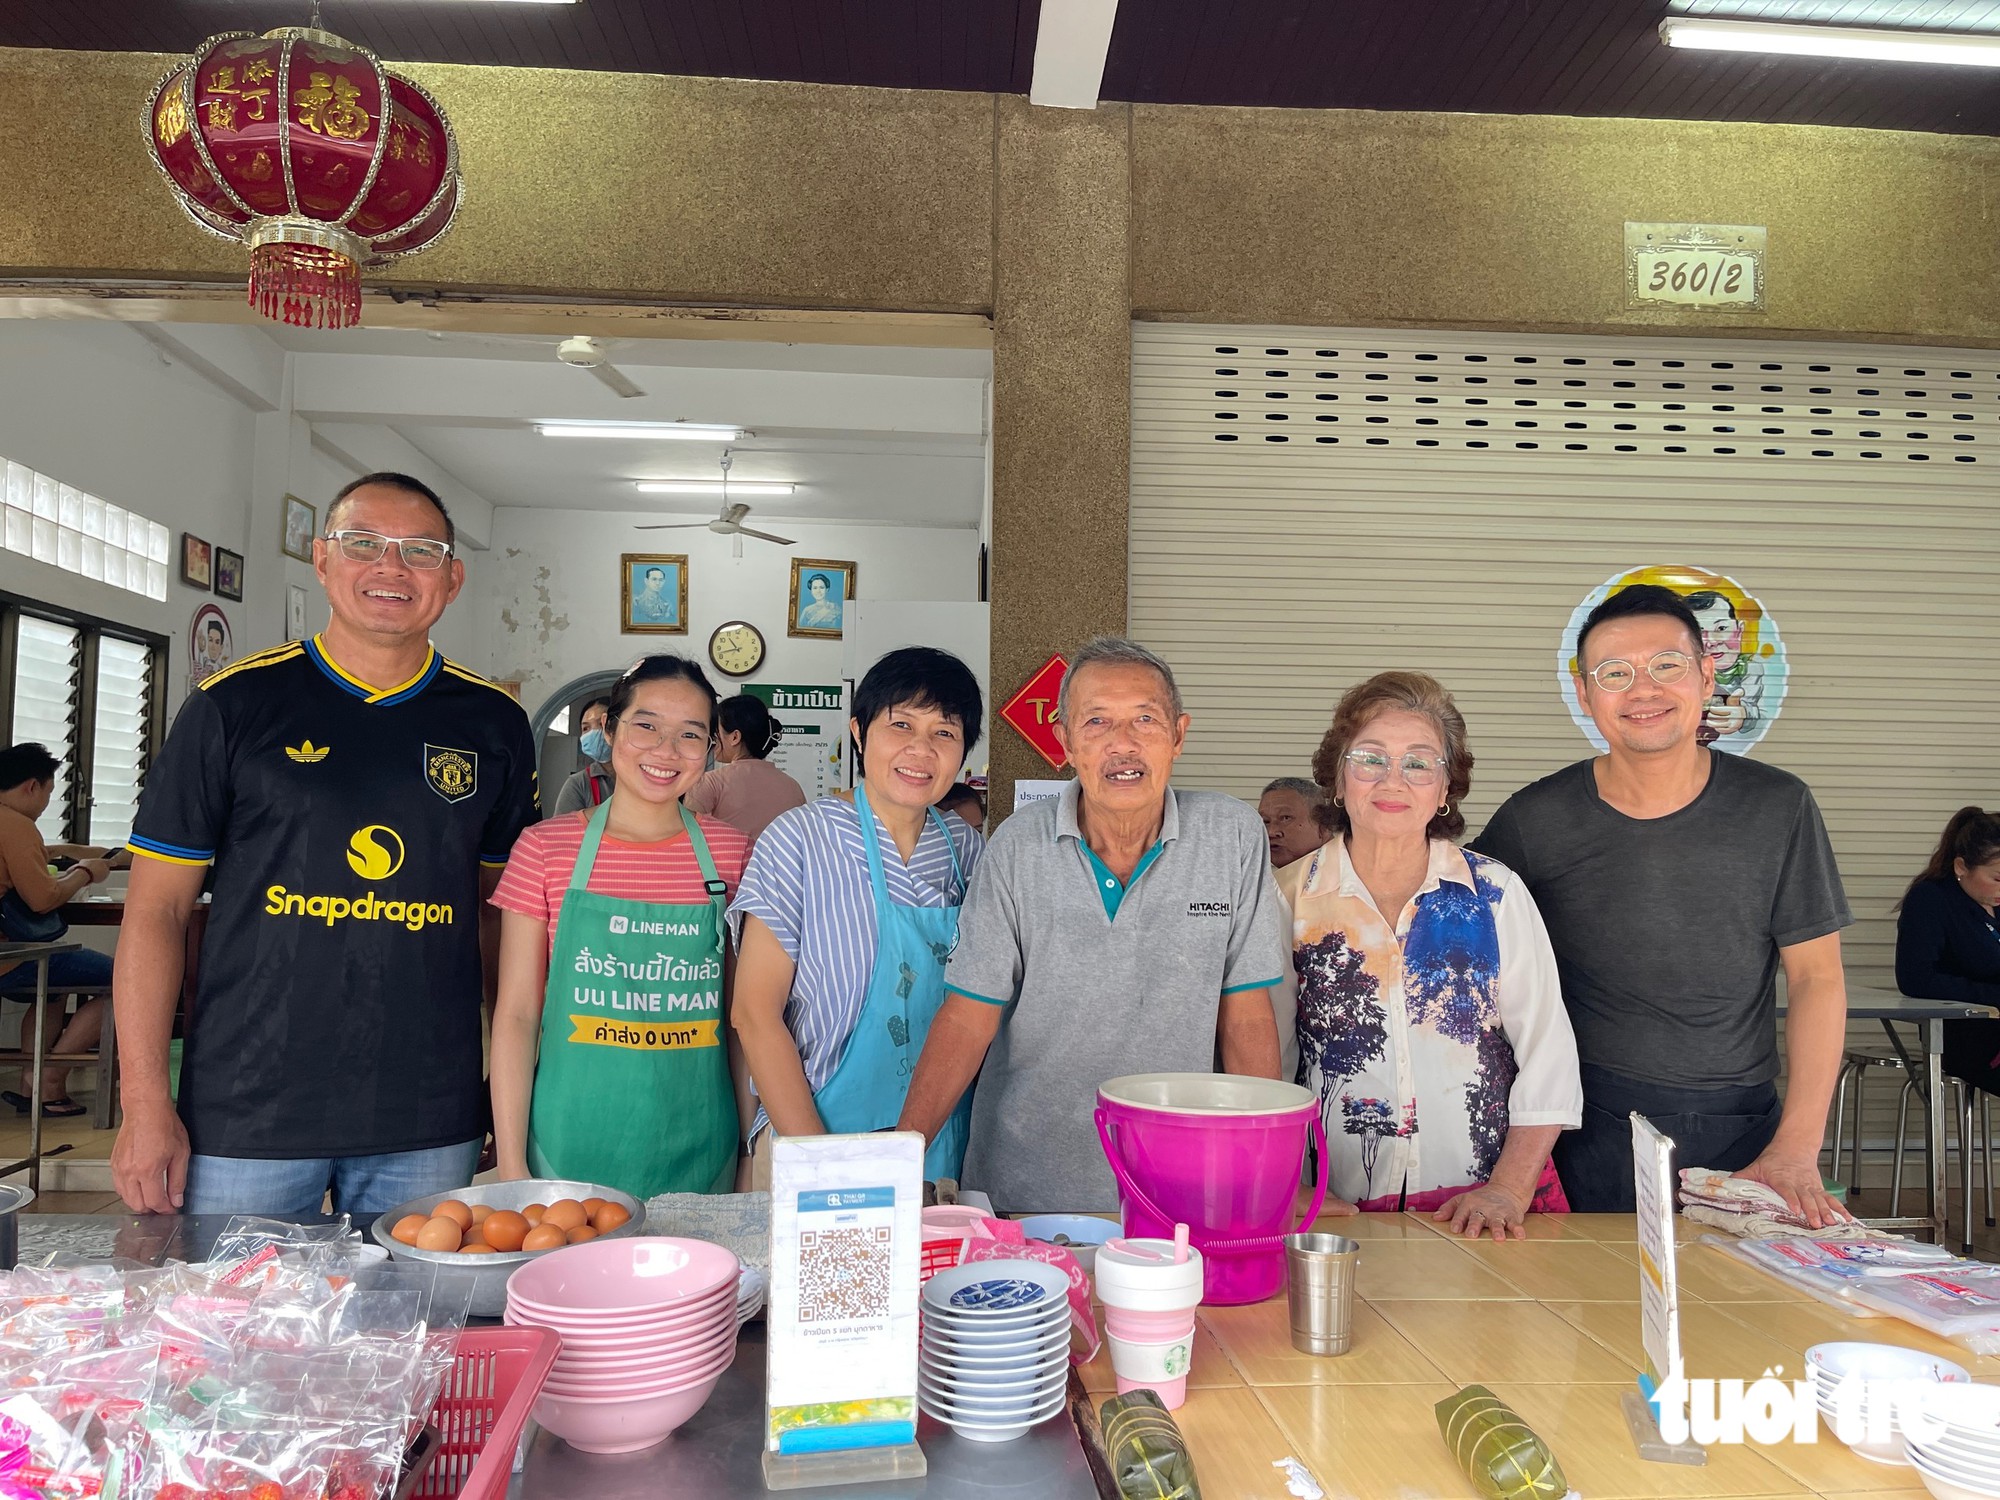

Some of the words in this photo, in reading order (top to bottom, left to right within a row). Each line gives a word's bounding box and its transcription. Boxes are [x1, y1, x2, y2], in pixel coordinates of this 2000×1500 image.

[294, 71, 371, 141] 福
[1648, 257, 1743, 297] 360/2
[772, 688, 842, 707] ข้าวเปีย
[433, 755, 469, 772] MANCHESTER
[440, 782, 464, 792] UNITED
[265, 885, 453, 931] Snapdragon
[1189, 902, 1230, 911] HITACHI
[631, 920, 664, 936] LINE
[665, 923, 700, 937] MAN
[574, 946, 721, 982] สั่งร้านนี้ได้แล้ว
[574, 986, 605, 1008] บน
[611, 990, 662, 1013] LINE
[667, 990, 719, 1013] MAN
[595, 1021, 641, 1045] ค่าส่ง
[645, 1030, 657, 1047] 0
